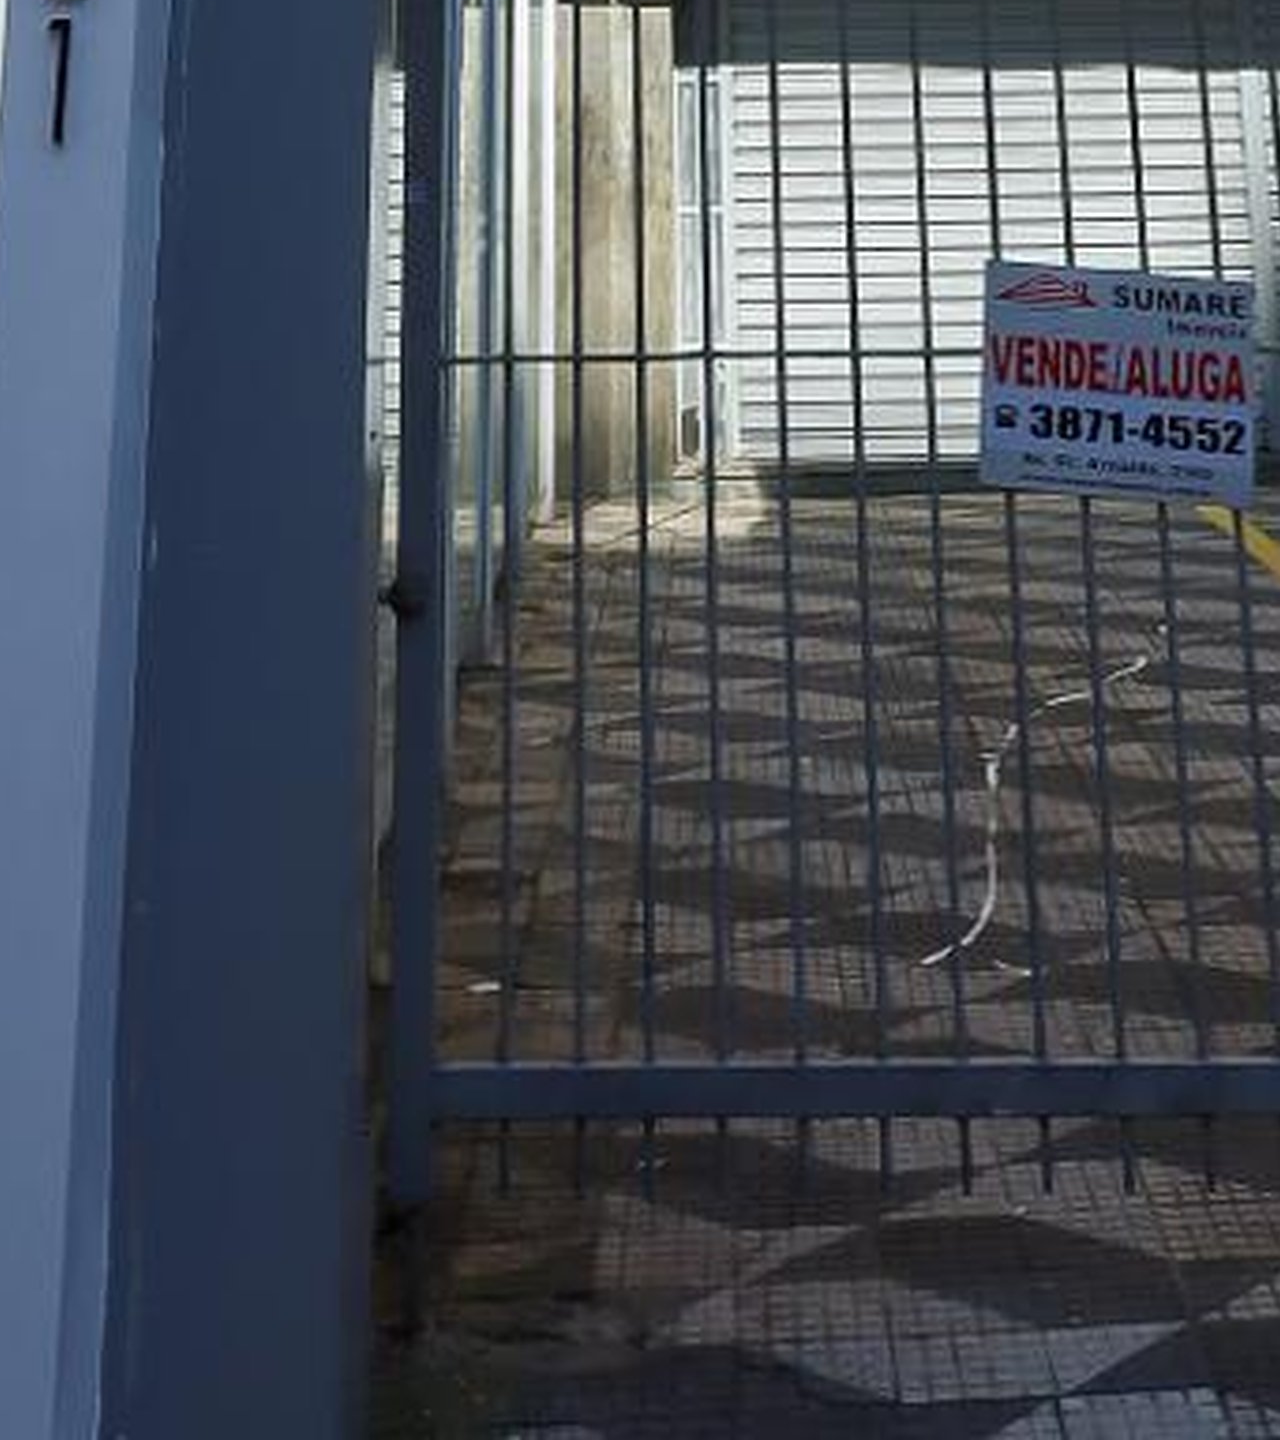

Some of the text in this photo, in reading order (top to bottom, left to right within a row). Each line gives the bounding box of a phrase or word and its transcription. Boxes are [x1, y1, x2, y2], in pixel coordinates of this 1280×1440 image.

[1113, 283, 1247, 320] SUMARÉ
[991, 333, 1247, 404] VENDE/ALUGA
[1028, 403, 1248, 456] 3871-4552
